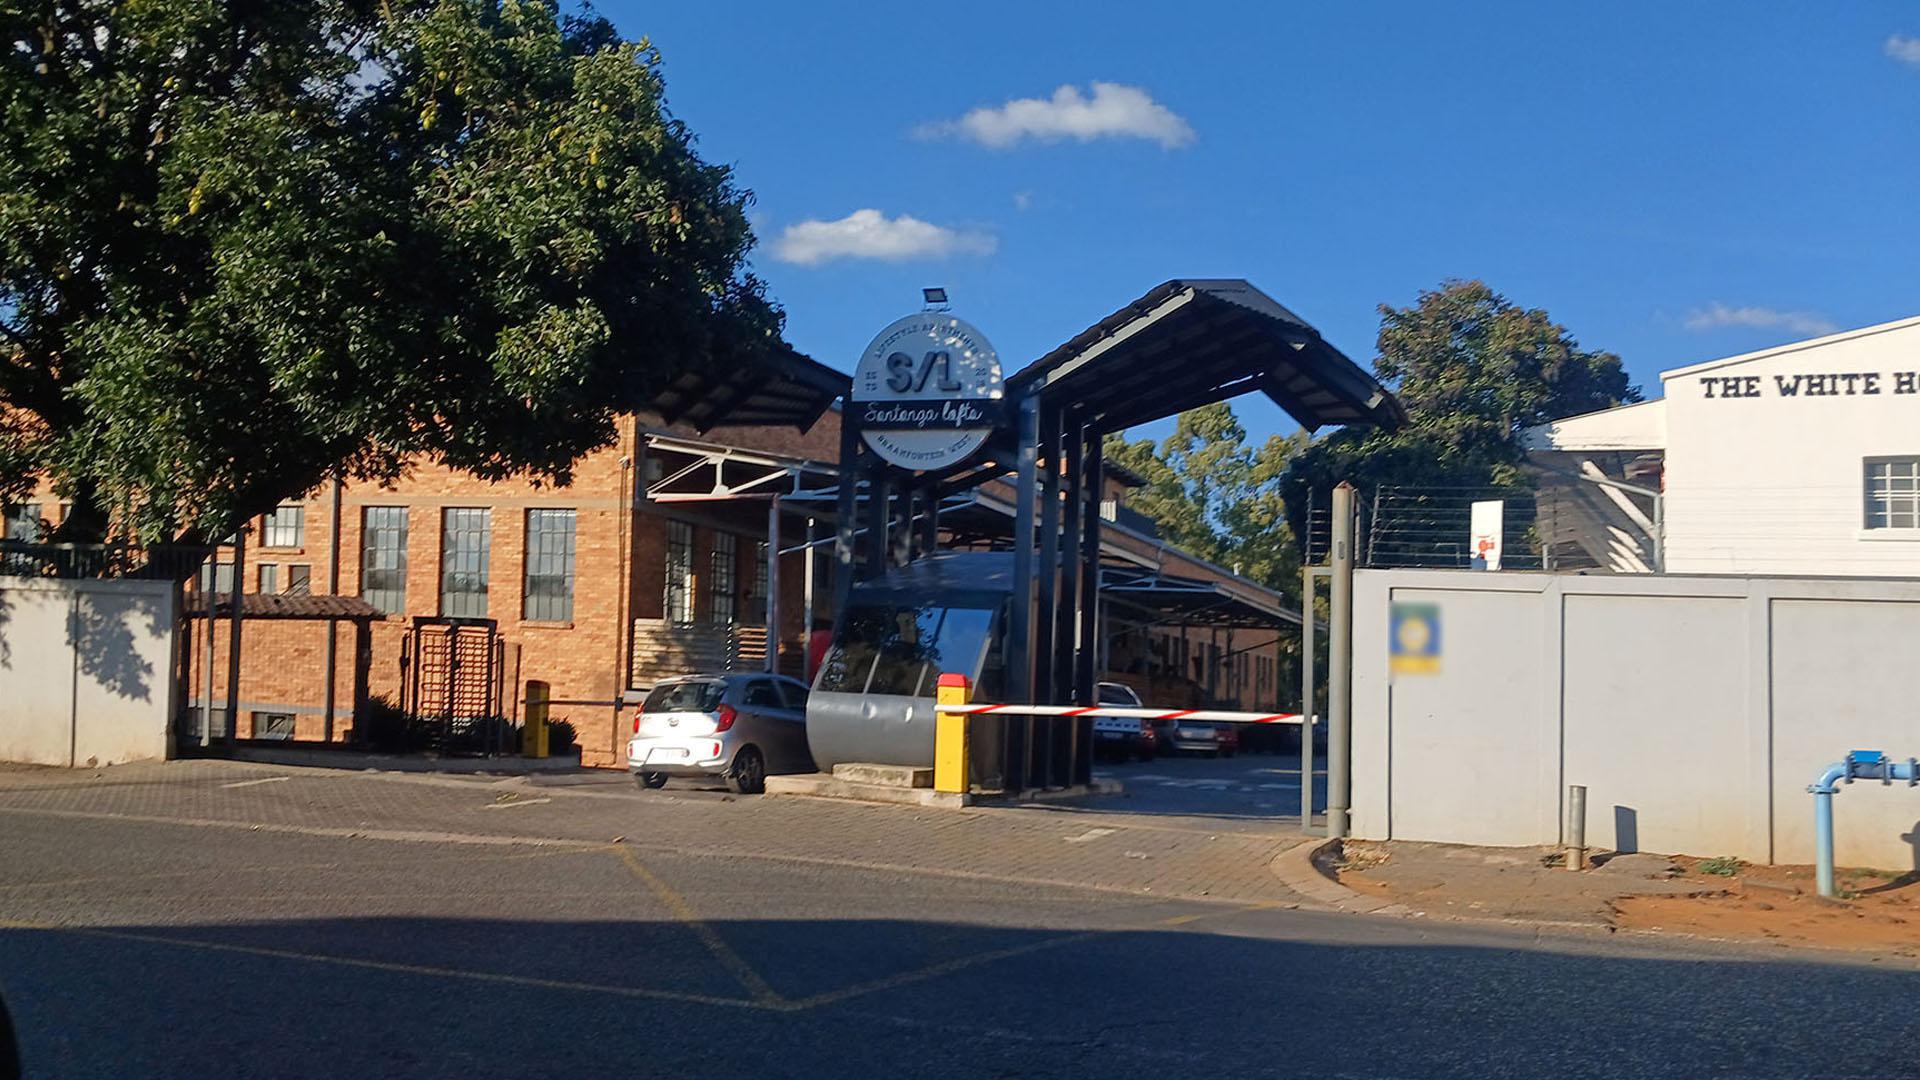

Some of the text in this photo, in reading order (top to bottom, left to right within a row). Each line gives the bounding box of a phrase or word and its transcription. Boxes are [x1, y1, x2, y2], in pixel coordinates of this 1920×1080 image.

[886, 351, 962, 393] S/L
[1700, 371, 1920, 399] THE WHITE H
